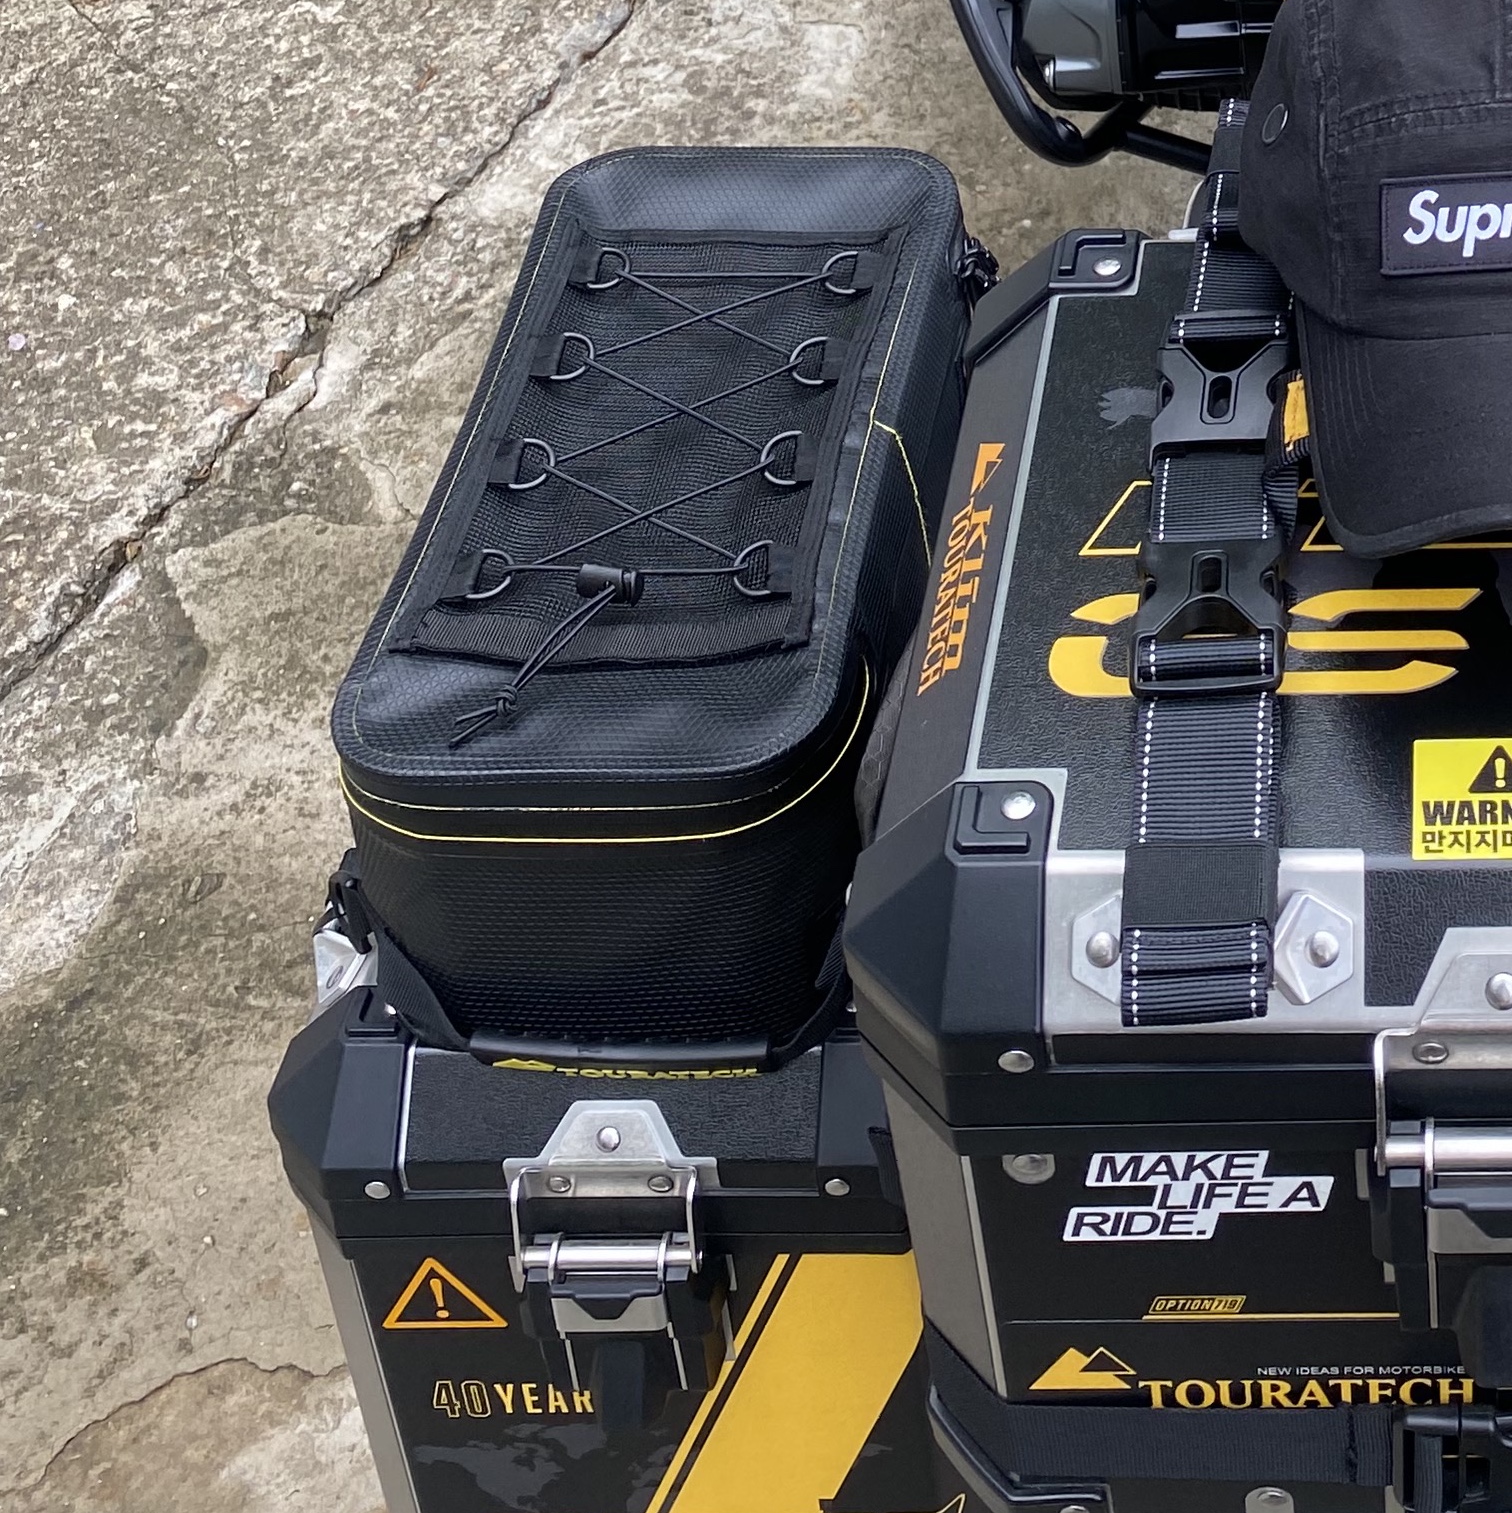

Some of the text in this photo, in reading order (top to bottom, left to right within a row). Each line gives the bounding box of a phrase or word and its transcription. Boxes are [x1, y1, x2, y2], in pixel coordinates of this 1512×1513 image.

[916, 496, 976, 697] TOURATECH
[556, 1068, 764, 1080] TOURATECH
[1095, 1153, 1260, 1183] MAKE
[1157, 1181, 1323, 1210] LIFE A
[1071, 1211, 1208, 1237] RIDE.
[1257, 1365, 1467, 1376] NEW IDEAS FOR MOTORBIKE
[432, 1380, 493, 1419] 40
[1138, 1378, 1476, 1410] TOURATECH
